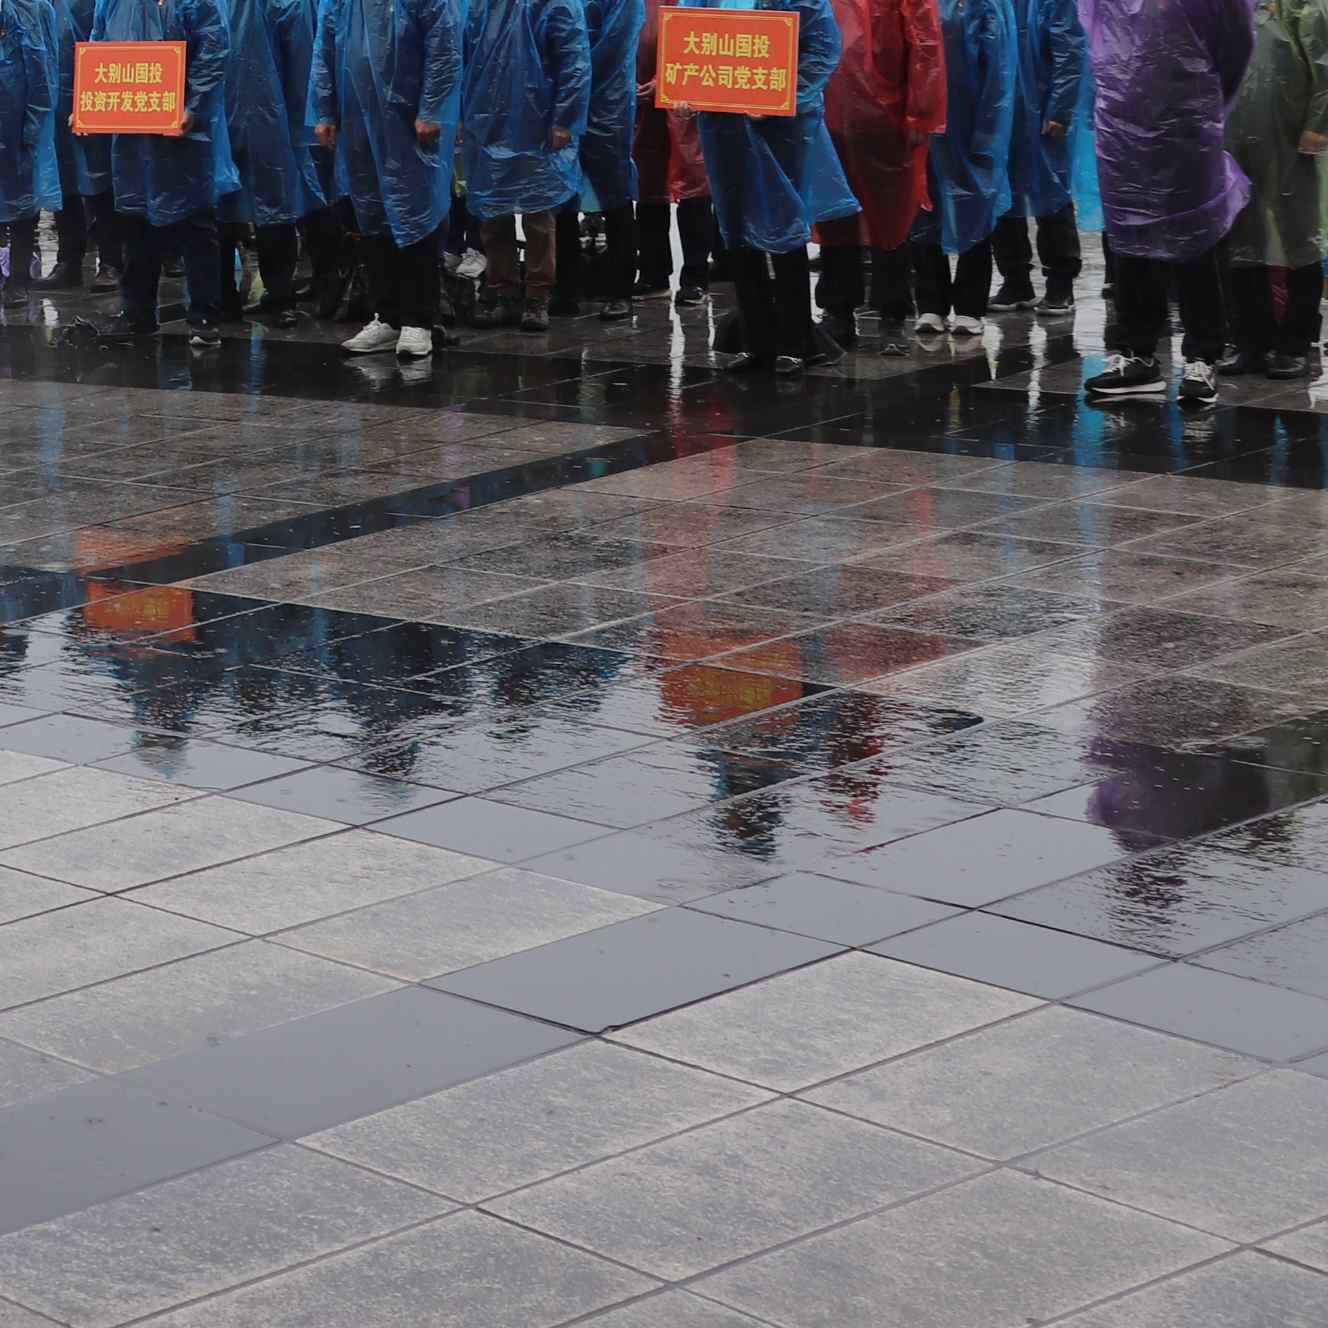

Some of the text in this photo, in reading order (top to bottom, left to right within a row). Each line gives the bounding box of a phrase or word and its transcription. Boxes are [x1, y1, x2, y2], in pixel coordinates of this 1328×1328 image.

[683, 31, 771, 59] 大别山国投
[94, 62, 163, 84] 大别山国投
[665, 62, 787, 92] 矿产公司党支部
[79, 90, 176, 113] 投资开发党支部
